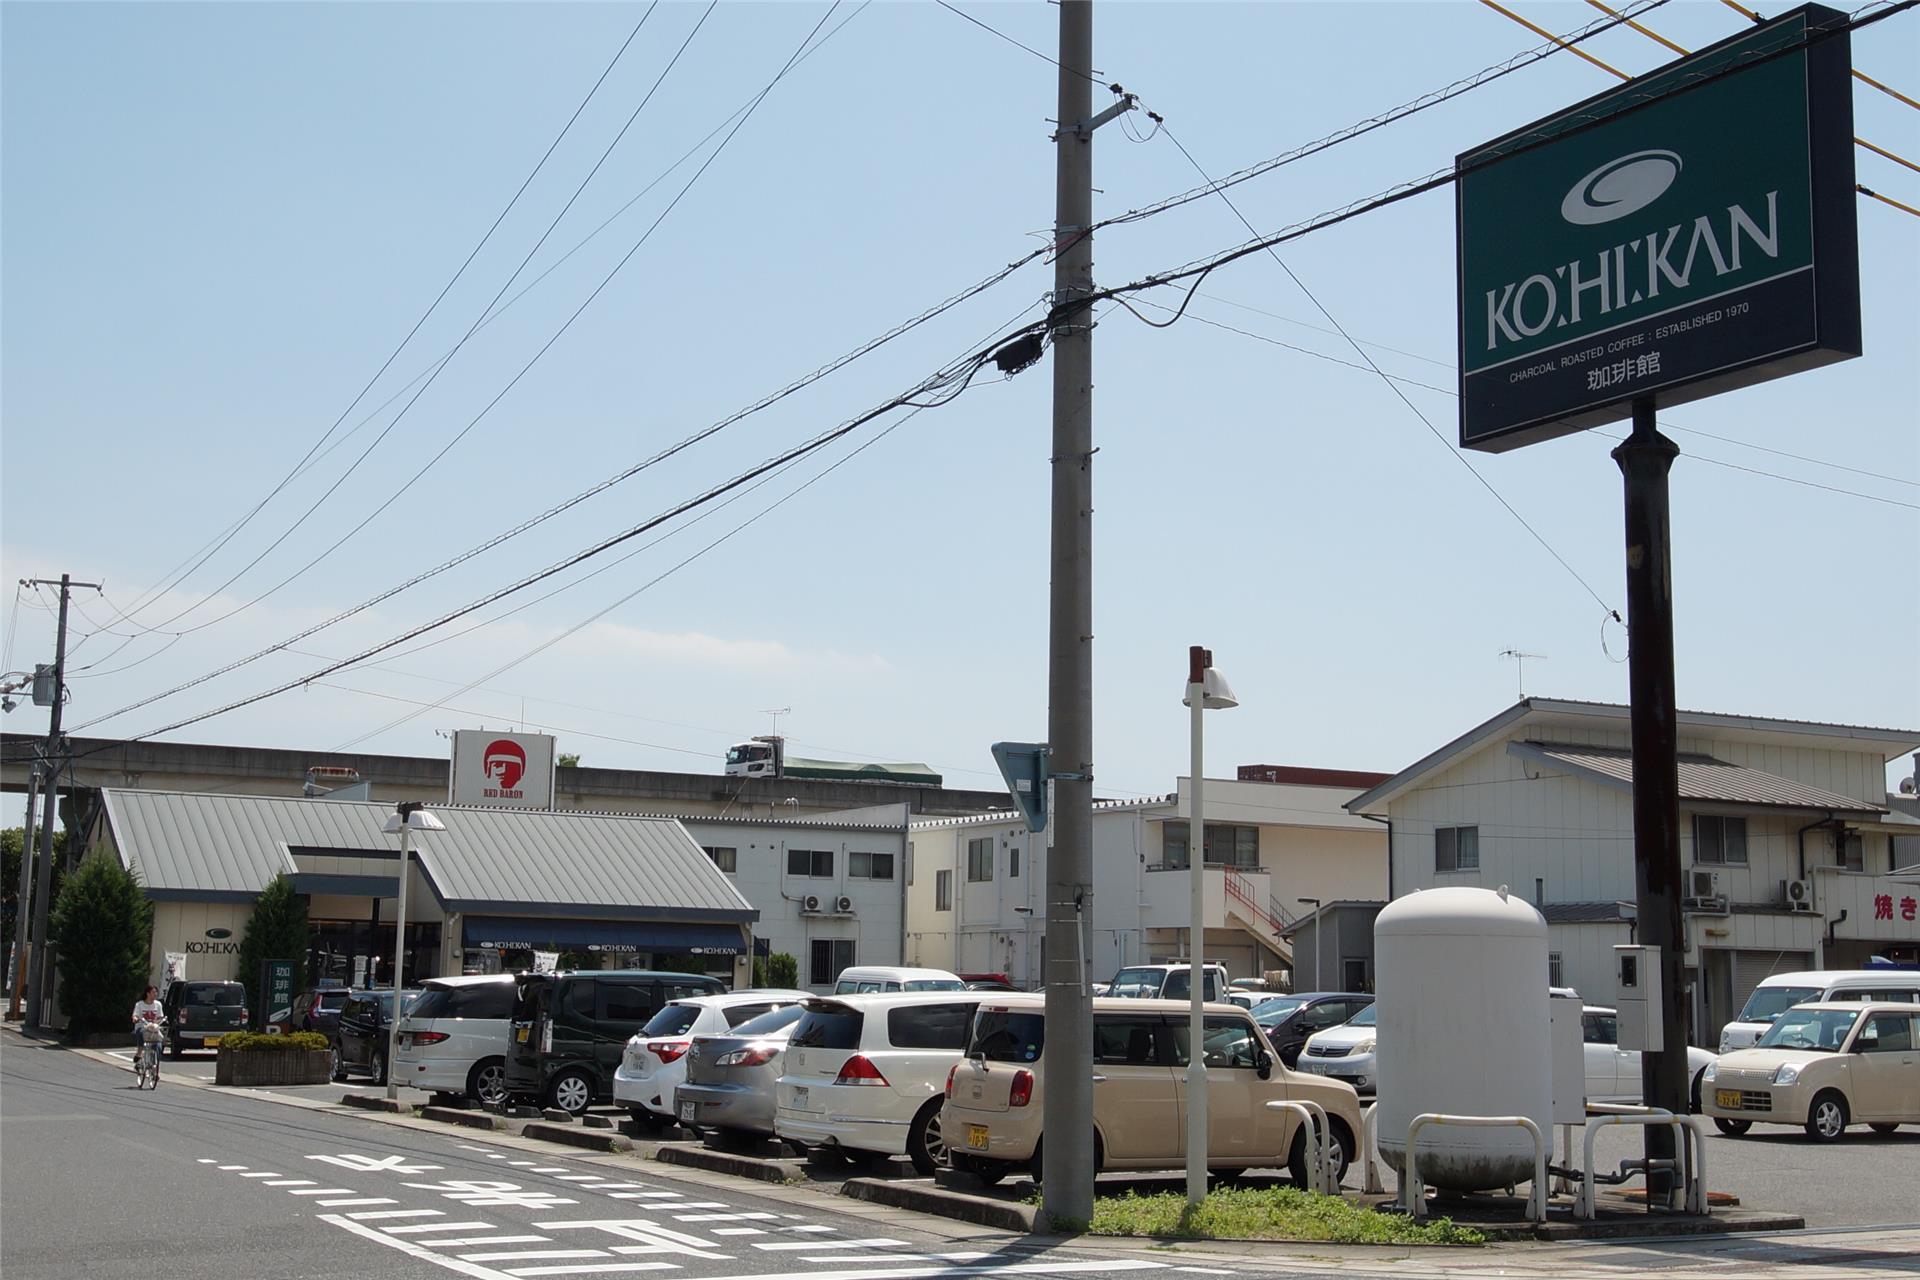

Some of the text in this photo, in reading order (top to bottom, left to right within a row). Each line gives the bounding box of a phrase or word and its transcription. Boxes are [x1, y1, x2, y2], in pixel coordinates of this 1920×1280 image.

[1509, 362, 1556, 383] CHARCOAL
[1561, 346, 1604, 368] ROASTED
[1608, 334, 1645, 353] COFFEE
[1655, 310, 1722, 339] ESTABLISHED
[1725, 302, 1750, 318] 1970
[1587, 351, 1661, 391] 珈琲館
[483, 788, 523, 799] RED BARON
[1874, 893, 1918, 921] 焼き
[274, 967, 290, 1003] 珈琲館
